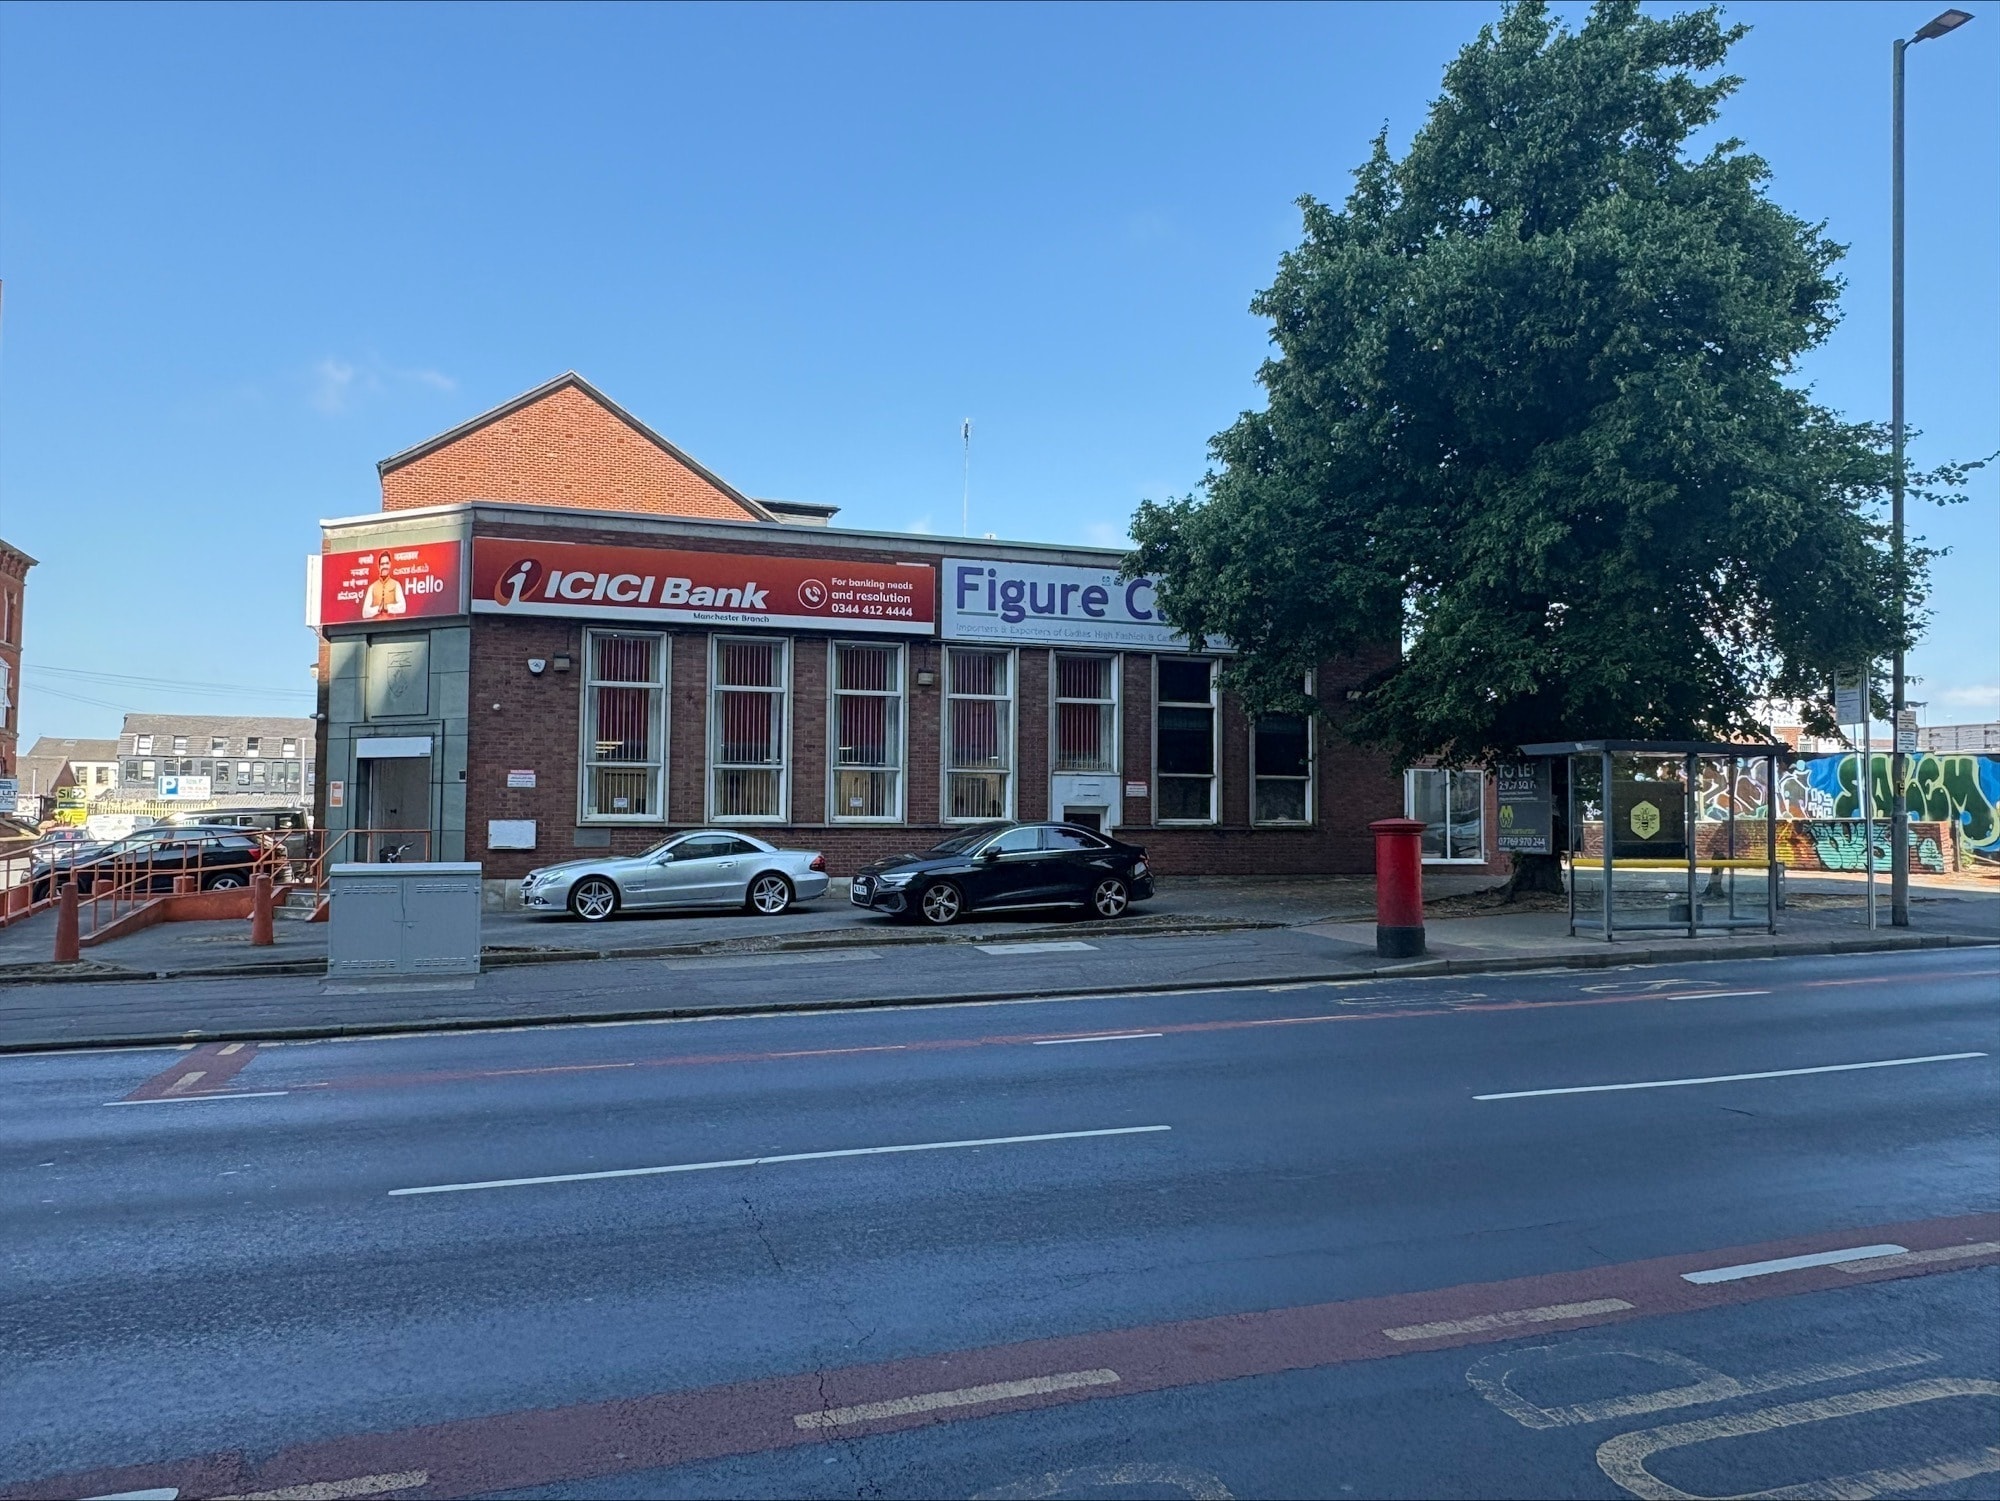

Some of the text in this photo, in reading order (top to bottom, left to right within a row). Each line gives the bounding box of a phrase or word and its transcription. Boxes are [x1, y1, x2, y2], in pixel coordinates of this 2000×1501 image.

[405, 575, 444, 595] Hello
[544, 570, 770, 609] ICICI Bank
[831, 577, 913, 590] For banking needs
[831, 590, 911, 603] and resolution
[957, 566, 1109, 623] Figure
[831, 603, 913, 617] 0344 412 4444
[693, 613, 770, 623] Manchester Branch
[956, 623, 998, 633] Importers
[1010, 627, 1050, 636] Exporters
[1095, 630, 1113, 640] High
[1115, 631, 1146, 641] Fashion
[1498, 837, 1518, 846] 07769
[1519, 837, 1532, 846] 970
